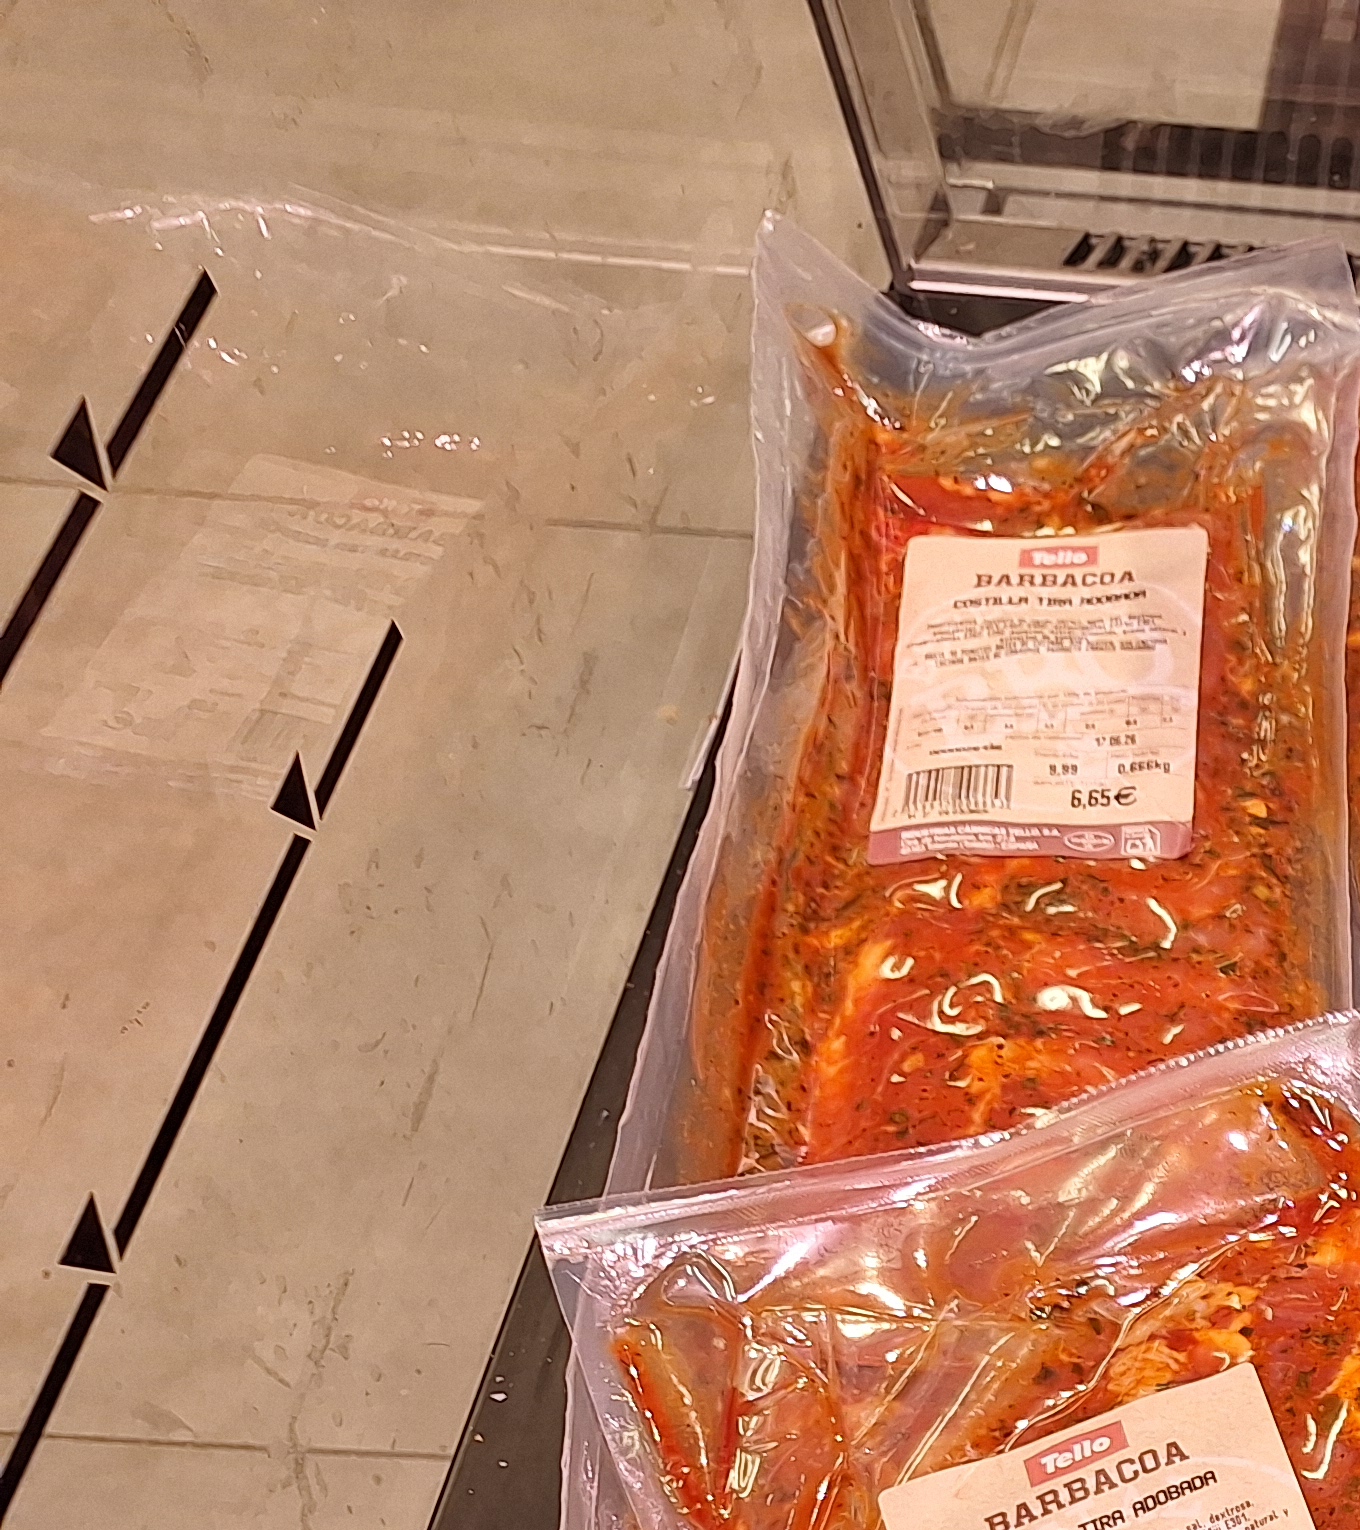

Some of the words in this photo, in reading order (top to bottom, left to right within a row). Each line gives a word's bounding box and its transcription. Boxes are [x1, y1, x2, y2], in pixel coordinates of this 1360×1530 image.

[1030, 550, 1088, 567] Tello
[973, 568, 1136, 588] BARBACOA
[1069, 785, 1138, 810] 6,65€
[1038, 1431, 1113, 1476] Tello
[1130, 1469, 1218, 1517] ADOBADA
